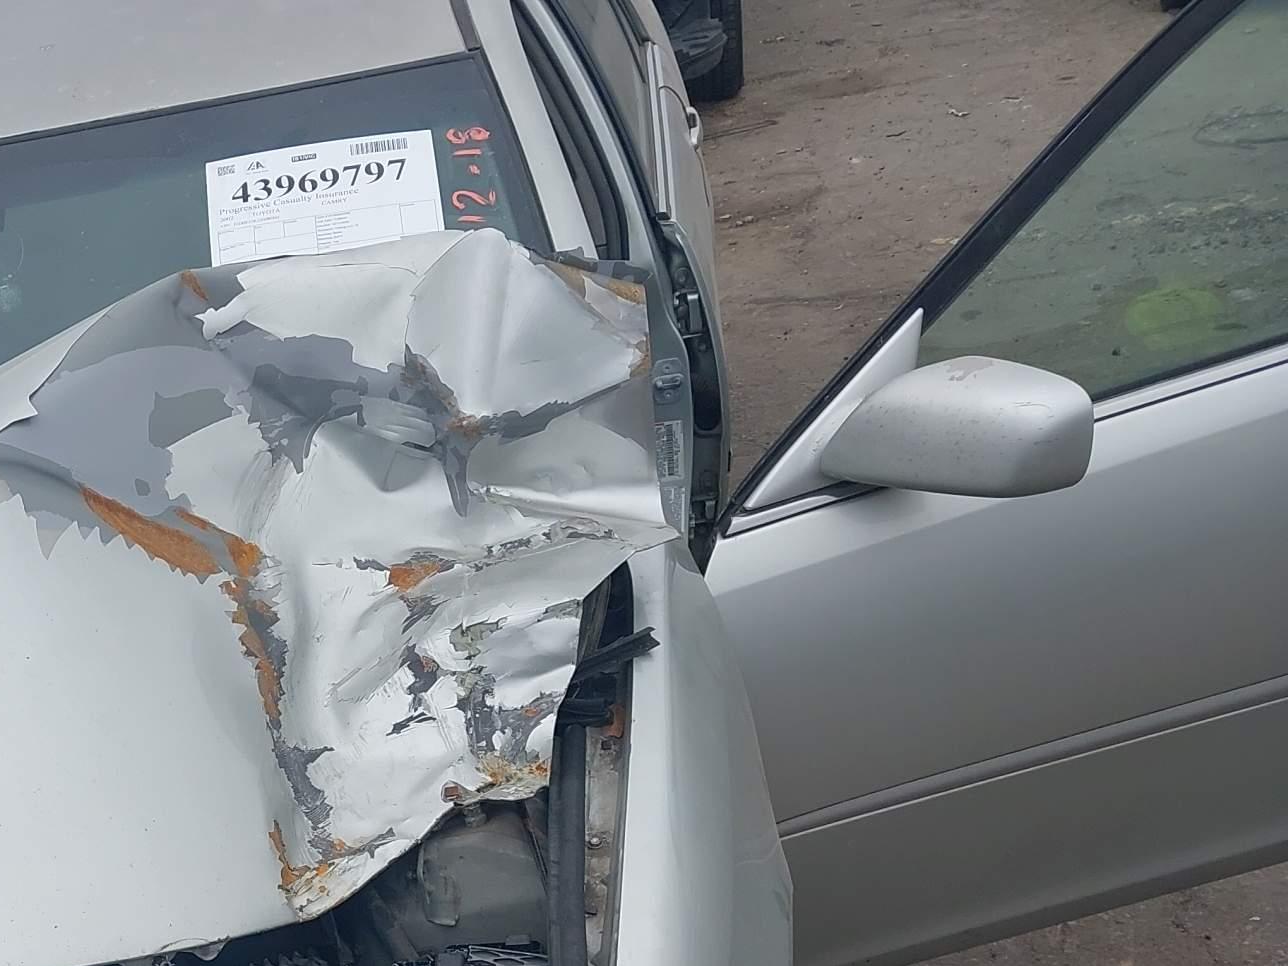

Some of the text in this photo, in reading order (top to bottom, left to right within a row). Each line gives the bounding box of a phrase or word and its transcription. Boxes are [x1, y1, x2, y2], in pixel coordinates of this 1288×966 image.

[231, 158, 407, 203] 43969797
[219, 187, 360, 216] Progressive Casualty Insurance
[321, 197, 348, 206] CAMRY
